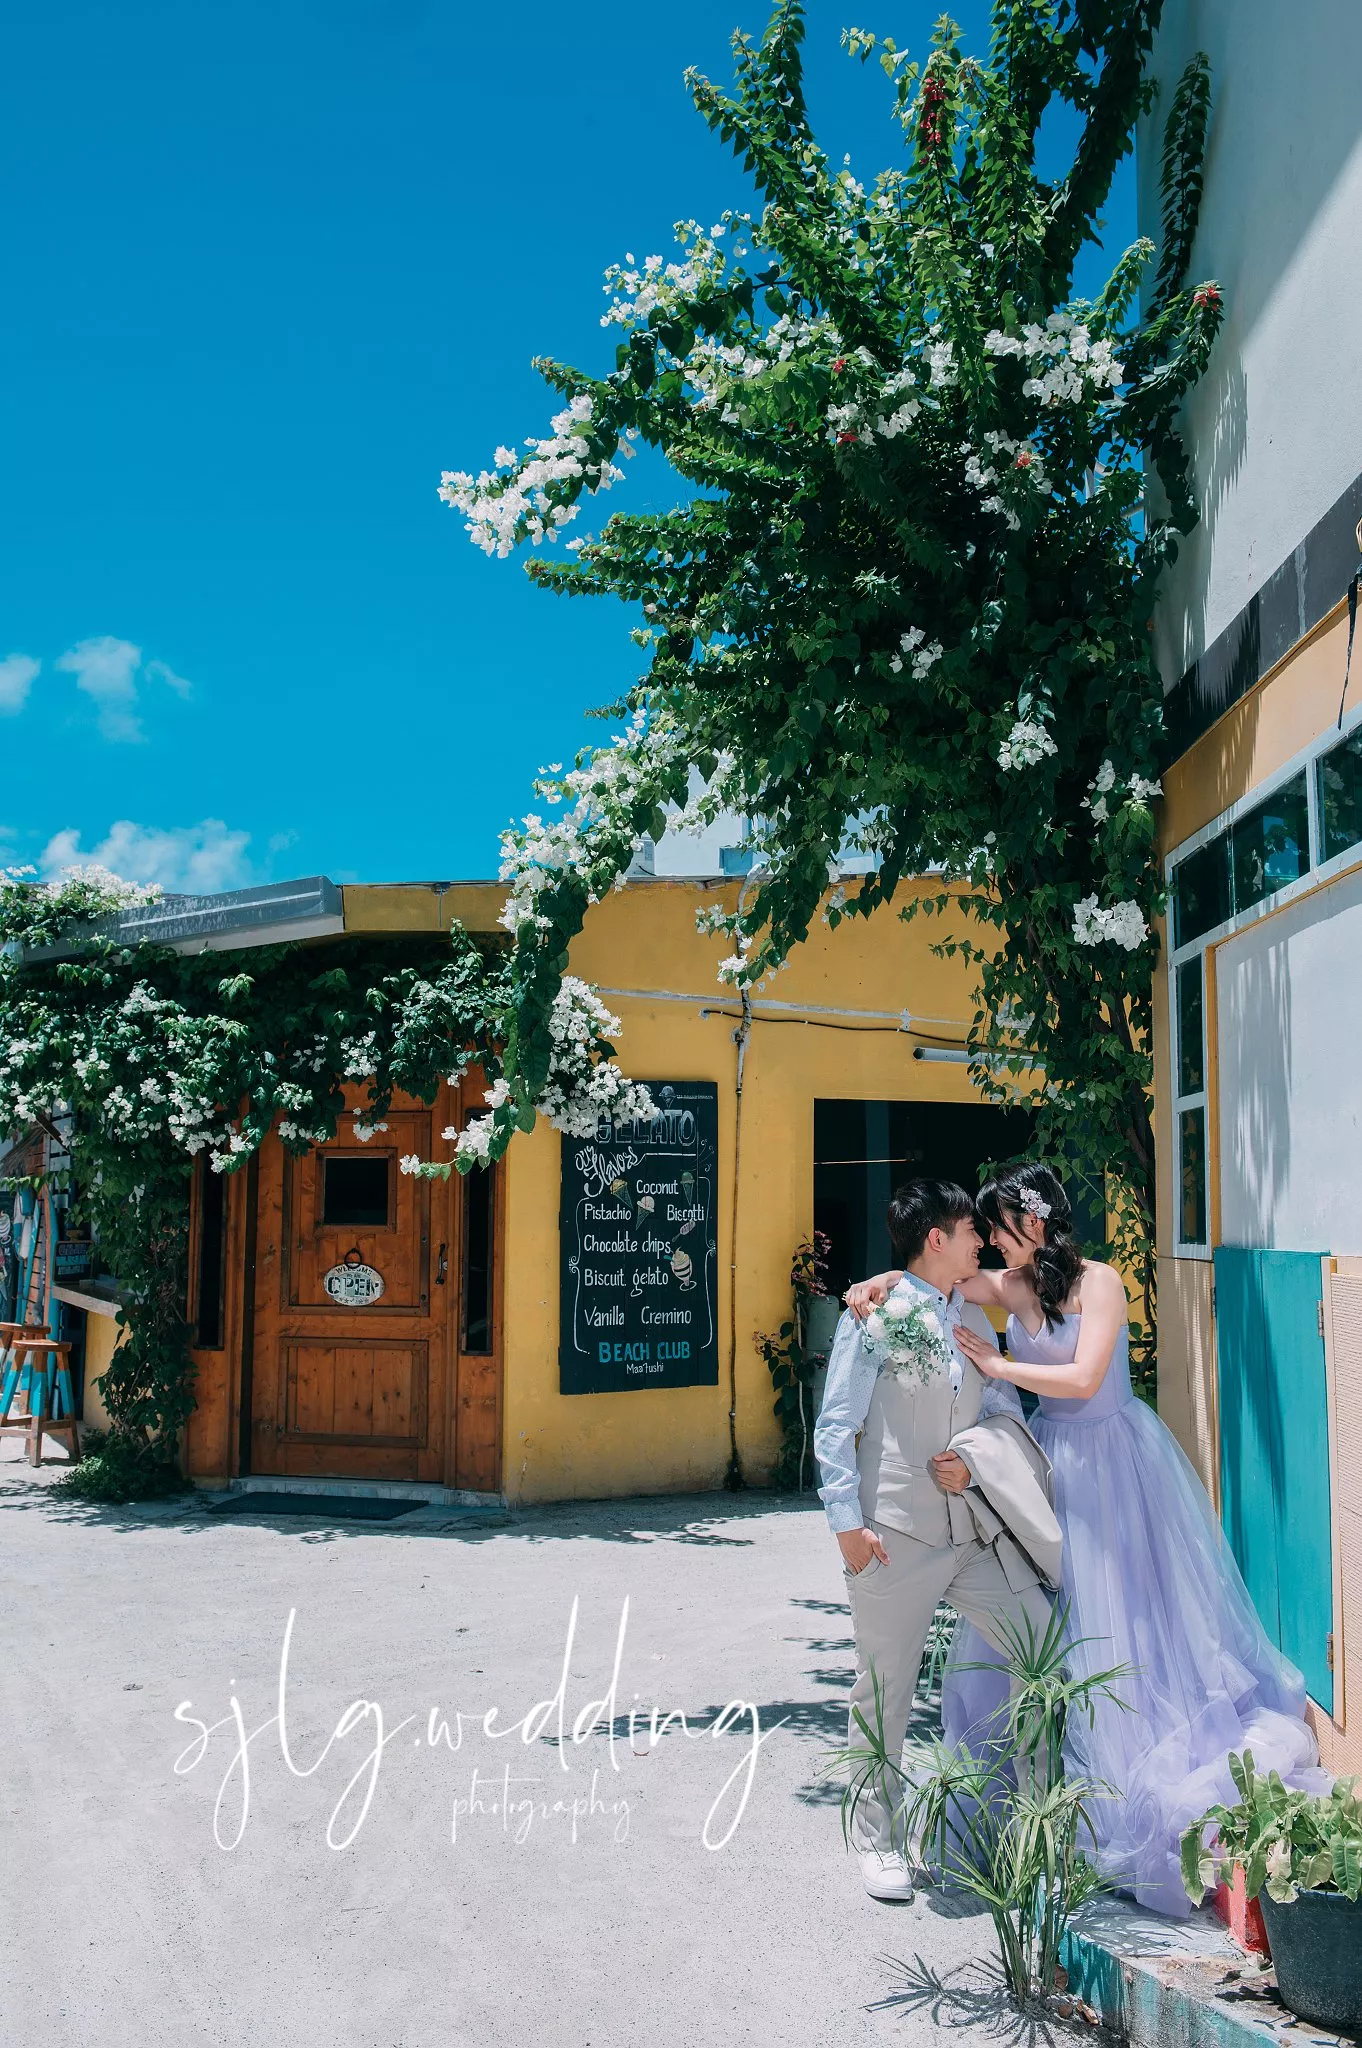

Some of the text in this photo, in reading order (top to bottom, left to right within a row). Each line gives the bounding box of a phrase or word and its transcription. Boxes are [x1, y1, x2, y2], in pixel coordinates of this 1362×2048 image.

[636, 1179, 679, 1195] Coconut
[584, 1203, 705, 1221] Pistachio Biscotti
[583, 1230, 671, 1259] Chocolate chips
[327, 1277, 380, 1297] OPEN
[630, 1266, 669, 1297] gelato
[584, 1305, 692, 1327] Vanilla Cremino
[598, 1341, 690, 1363] BEACH CLUB
